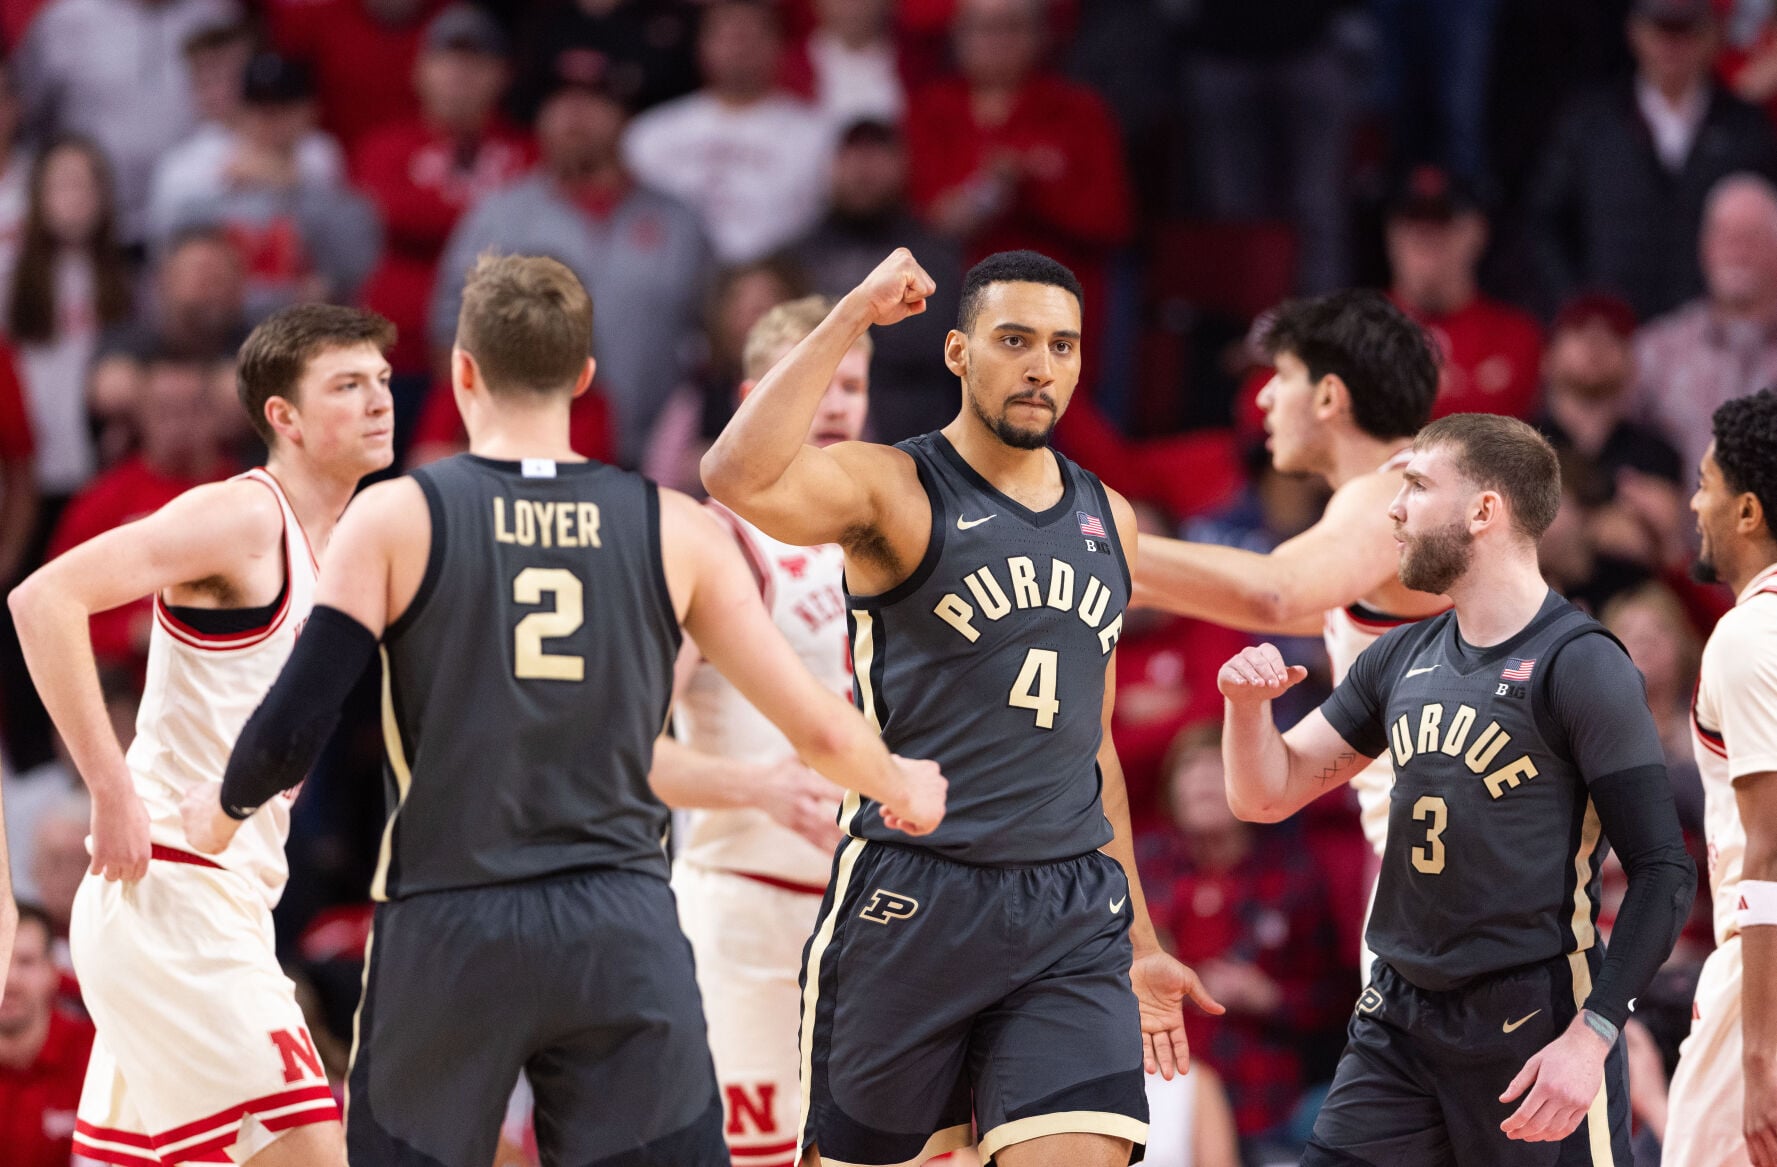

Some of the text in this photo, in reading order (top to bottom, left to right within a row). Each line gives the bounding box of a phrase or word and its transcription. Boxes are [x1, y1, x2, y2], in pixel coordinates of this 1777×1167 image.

[493, 496, 602, 548] LOYER
[513, 566, 585, 682] 2
[932, 555, 1124, 656] PURDUE
[1007, 647, 1060, 730] 4
[1390, 702, 1540, 800] URDUE
[1411, 795, 1448, 875] 3
[859, 888, 919, 925] P
[267, 1026, 325, 1084] N
[725, 1083, 777, 1136] N
